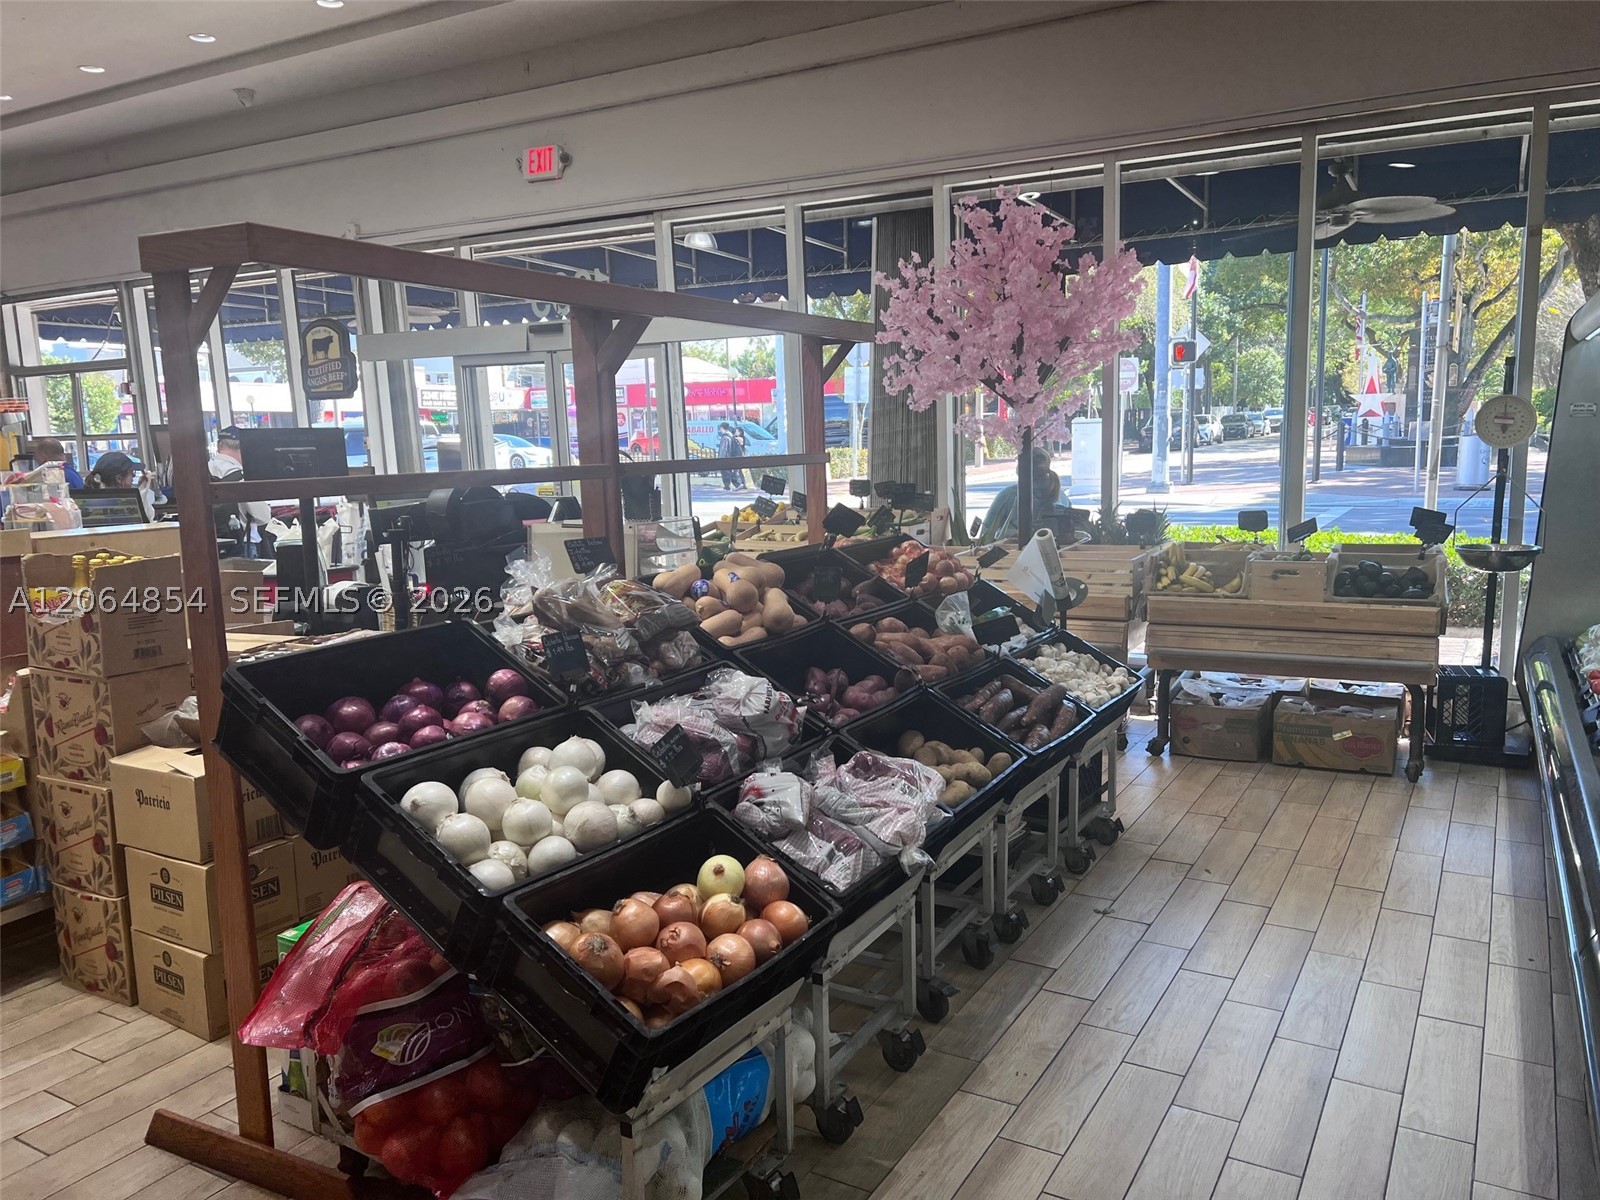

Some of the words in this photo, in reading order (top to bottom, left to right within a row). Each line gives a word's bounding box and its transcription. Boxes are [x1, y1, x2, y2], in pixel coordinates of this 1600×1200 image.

[528, 146, 554, 174] EXIT
[307, 361, 342, 377] CERTIFIED
[307, 374, 328, 388] ANGUS
[687, 426, 714, 434] ABALLO
[1275, 724, 1320, 736] Premium
[1275, 733, 1326, 746] BANANAS
[135, 788, 171, 811] Patricia
[151, 887, 184, 907] PILSEN
[251, 880, 279, 900] SEN
[155, 968, 185, 991] PILSEN
